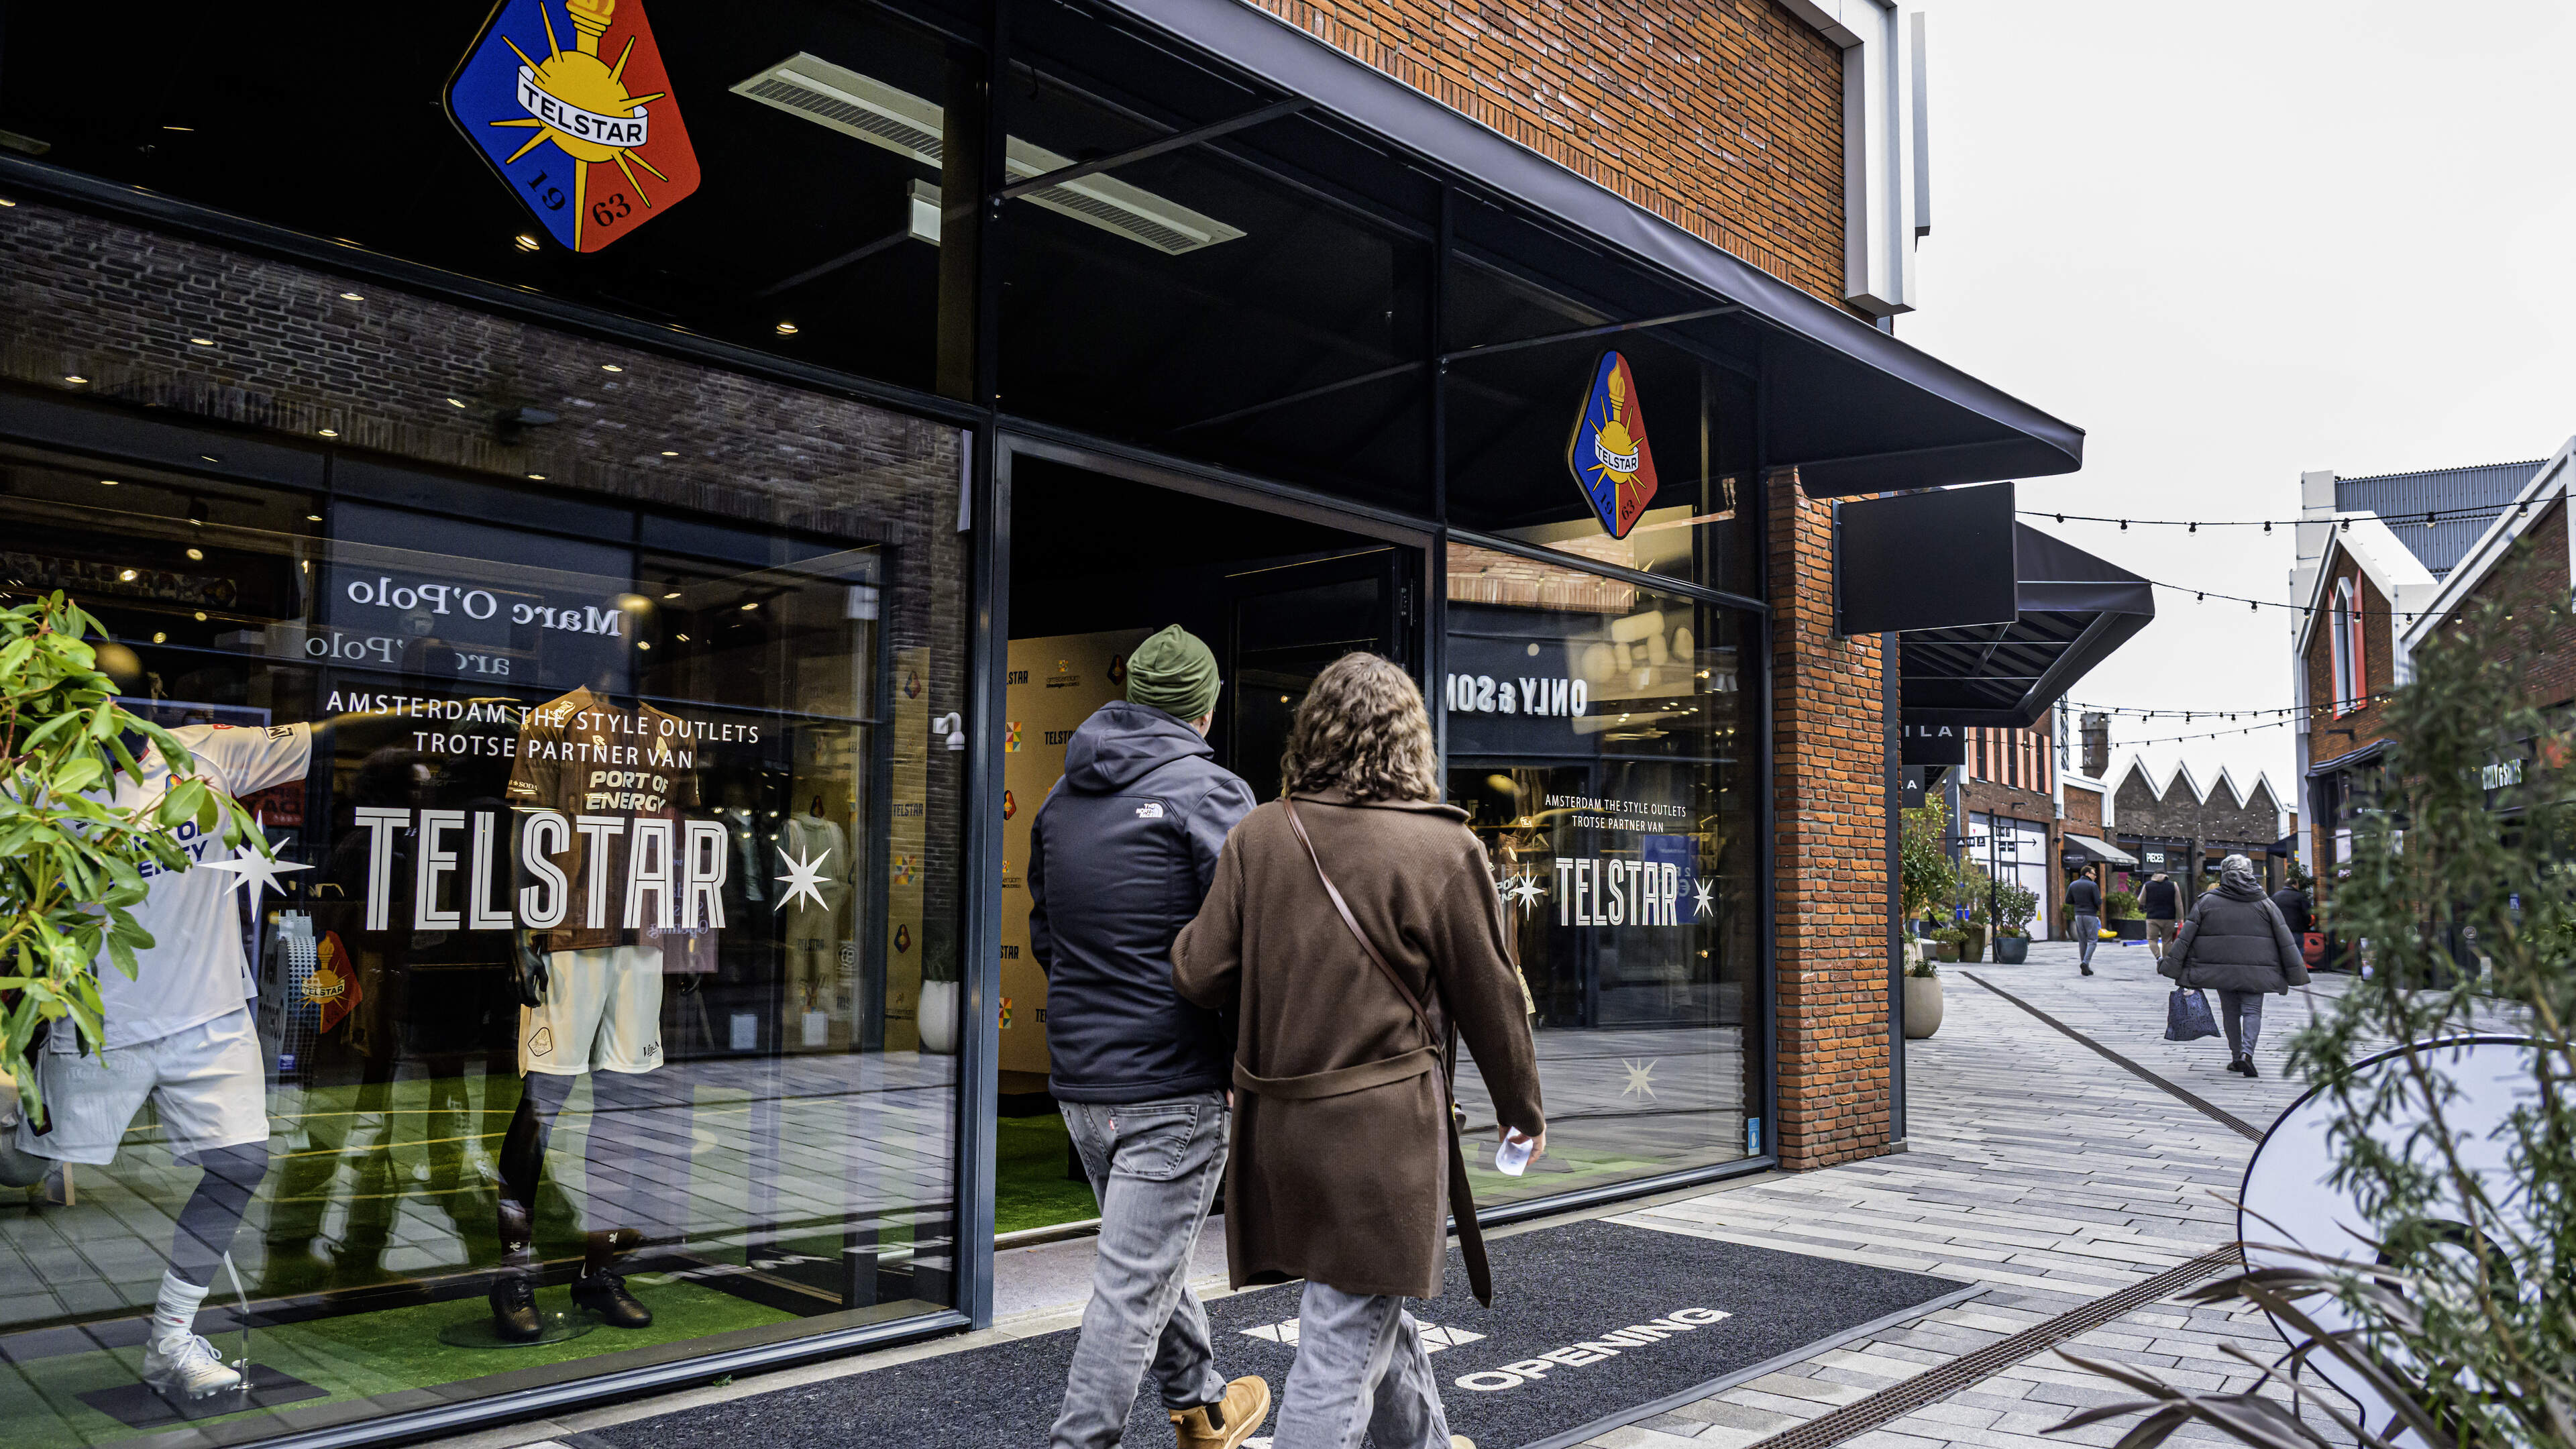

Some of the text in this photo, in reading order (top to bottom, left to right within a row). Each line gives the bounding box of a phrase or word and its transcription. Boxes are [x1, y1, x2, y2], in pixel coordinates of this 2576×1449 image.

[522, 83, 643, 143] TELSTAR
[527, 170, 632, 227] 19 63
[1597, 445, 1637, 470] TELSTAR
[1601, 494, 1635, 520] 19 63
[1006, 671, 1028, 685] STAR
[326, 691, 505, 724] AMSTERDAM
[518, 706, 565, 729] THE
[577, 712, 648, 735] STYLE
[660, 718, 759, 744] OUTLETS
[1905, 725, 1953, 737] ILA
[413, 731, 692, 769] TROTSE PARTNER VAN
[590, 771, 669, 794] PORT OF
[586, 792, 667, 814] ENERGY
[894, 804, 924, 816] TELSTAR
[1545, 794, 1686, 817] AMSTERDAM THE STYLE OUTLETS
[1572, 815, 1664, 833] TROTSE PARTNER VAN
[355, 807, 729, 931] TELSTAR
[1556, 857, 1678, 926] TELSTAR
[1000, 945, 1019, 959] STAR
[303, 985, 343, 996] TELSTAR
[1455, 1307, 1733, 1391] OPENING
